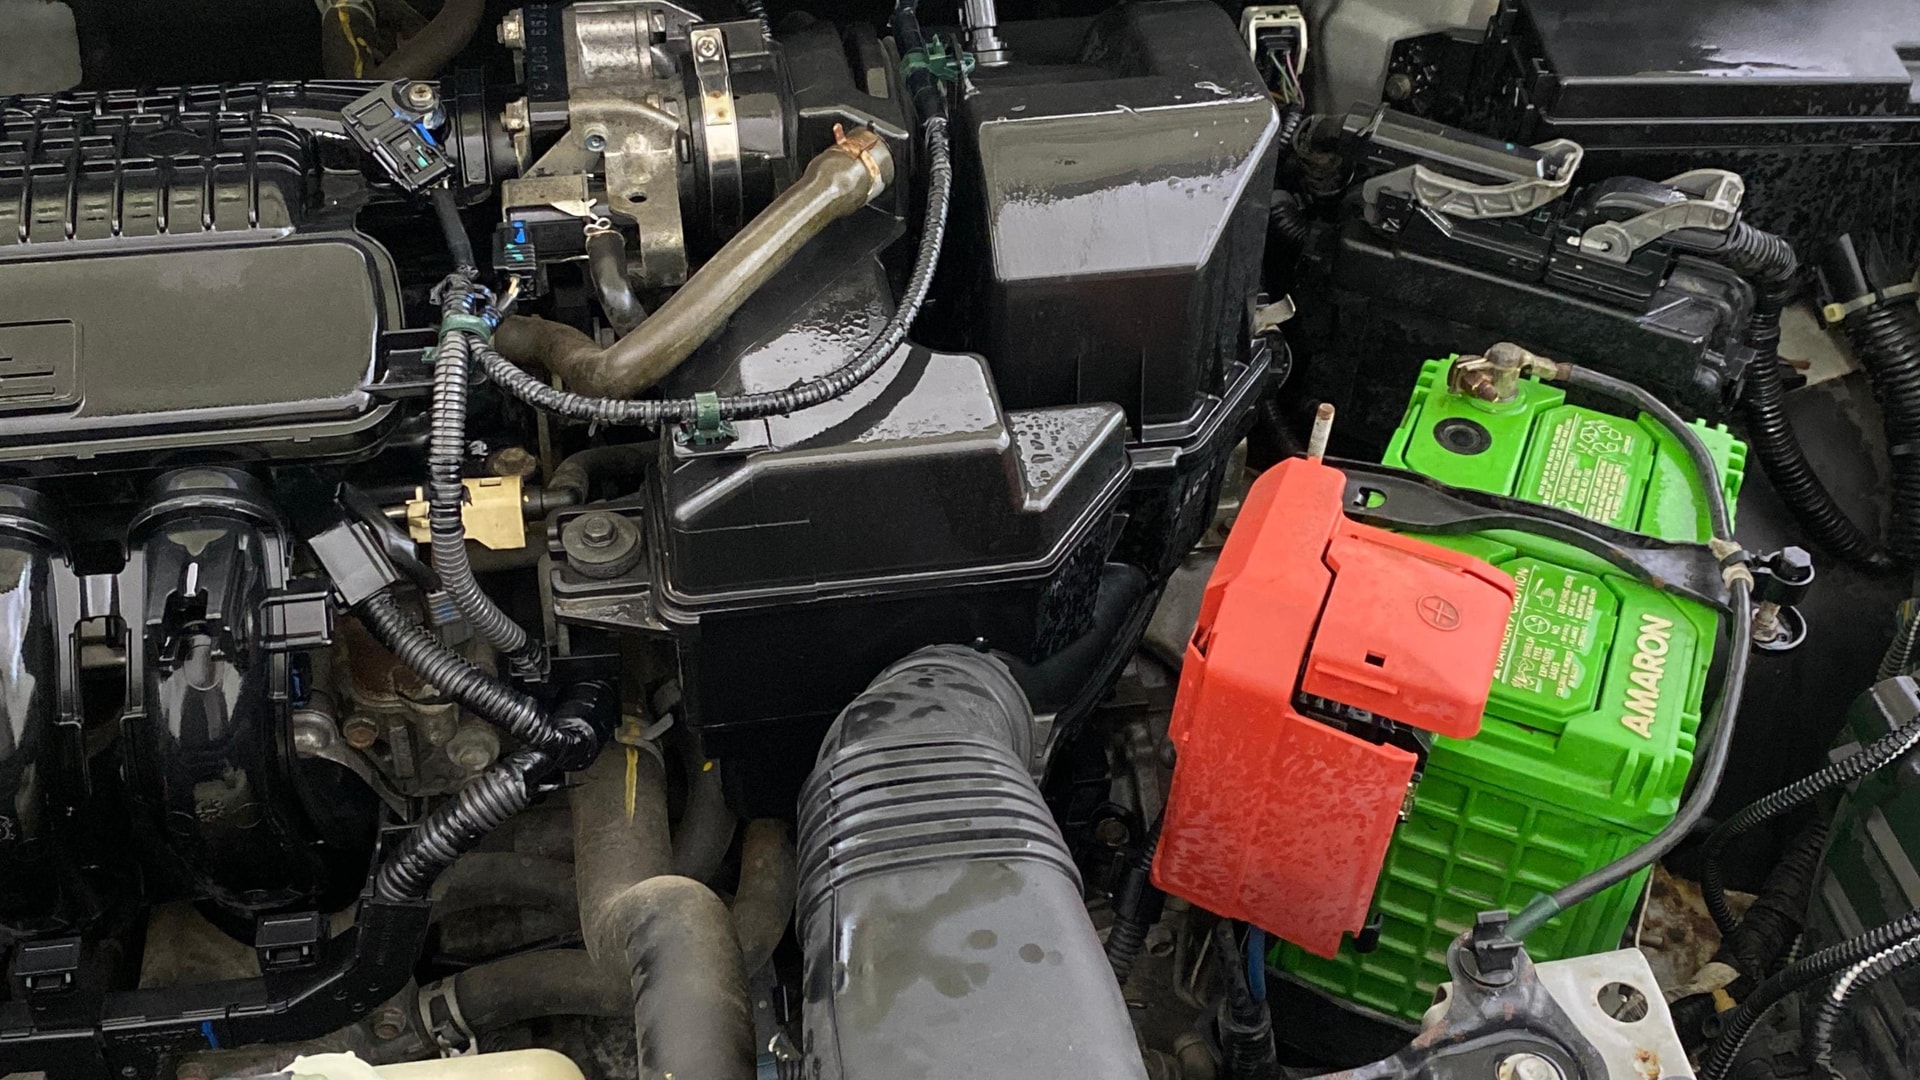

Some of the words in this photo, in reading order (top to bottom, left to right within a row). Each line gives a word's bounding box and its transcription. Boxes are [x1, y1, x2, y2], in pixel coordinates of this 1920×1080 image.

[1510, 567, 1529, 614] CAUTION
[1550, 624, 1561, 635] NO
[1532, 646, 1543, 660] EYES
[1548, 660, 1560, 680] GASES
[1621, 614, 1674, 739] AMARON
